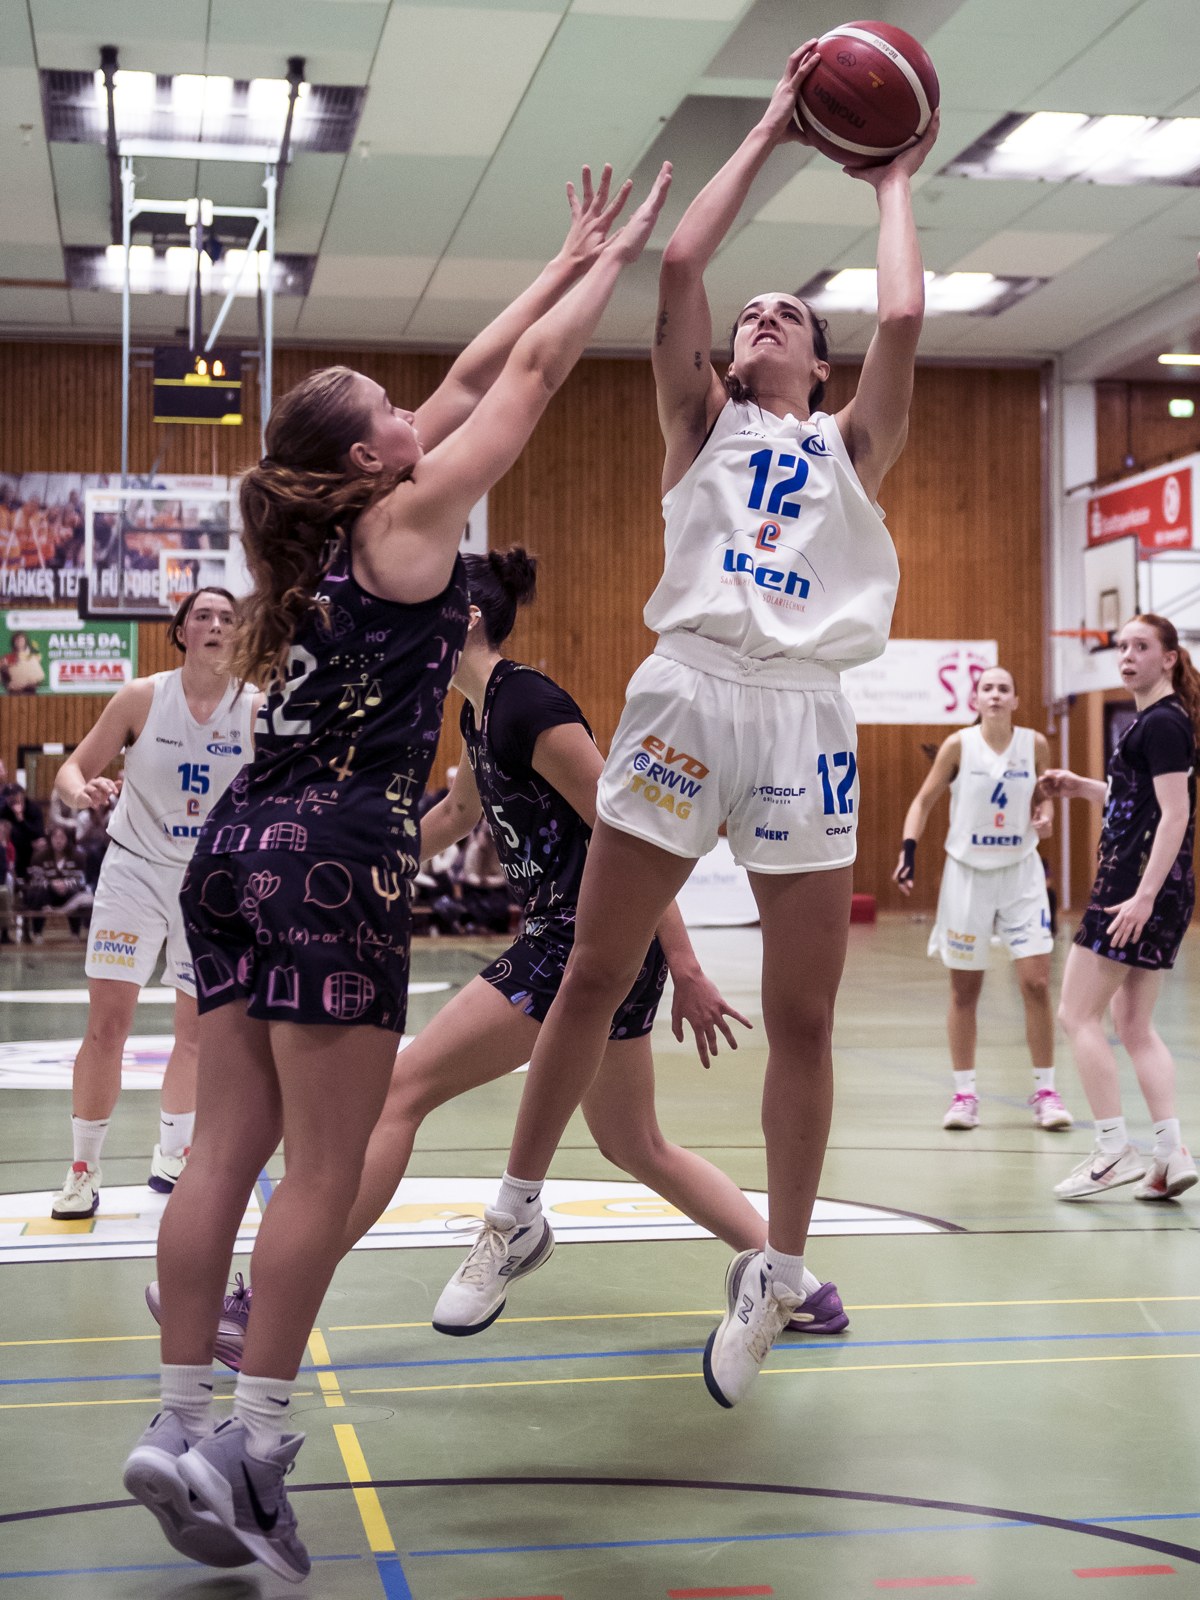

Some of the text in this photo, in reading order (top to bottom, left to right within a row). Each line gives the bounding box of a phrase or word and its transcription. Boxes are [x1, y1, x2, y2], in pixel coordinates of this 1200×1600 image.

[747, 448, 810, 519] 12
[48, 633, 95, 649] ALLES
[177, 762, 210, 795] 15
[646, 762, 702, 799] RWW
[817, 751, 857, 815] 12
[990, 782, 1008, 809] 4
[826, 825, 852, 836] CRAF
[103, 941, 137, 956] RWW
